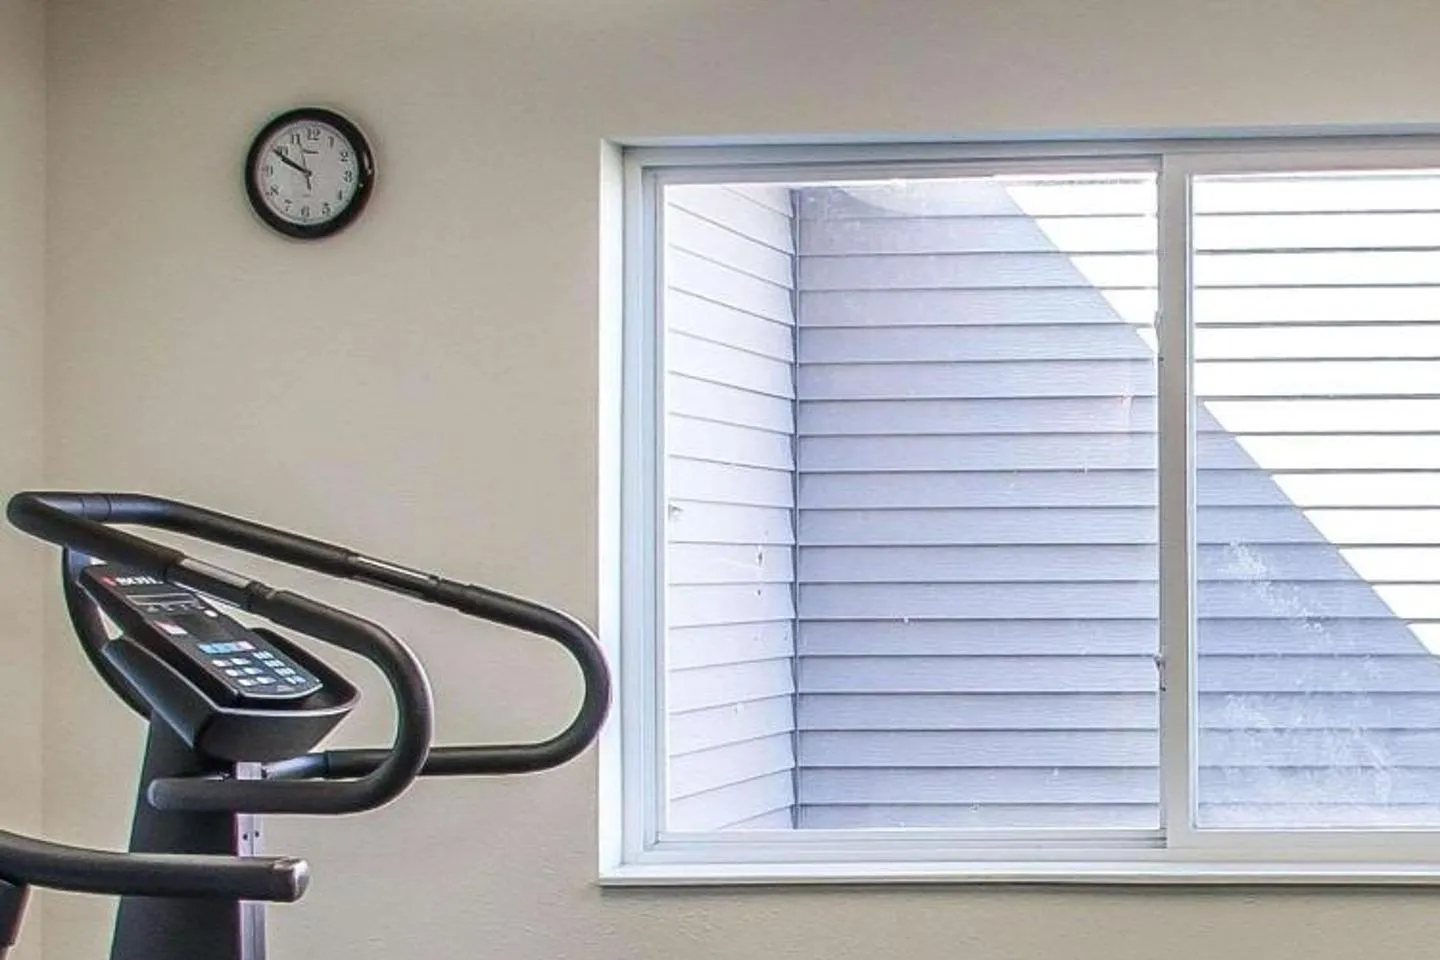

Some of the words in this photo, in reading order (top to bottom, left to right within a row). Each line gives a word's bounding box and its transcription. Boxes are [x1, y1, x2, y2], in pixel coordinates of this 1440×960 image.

[291, 134, 300, 144] 11
[307, 128, 320, 140] 12
[329, 136, 334, 147] 1
[340, 152, 348, 162] 2
[344, 171, 352, 182] 3
[271, 185, 279, 196] 8
[284, 199, 292, 212] 7
[322, 203, 331, 214] 5
[301, 206, 310, 217] 6
